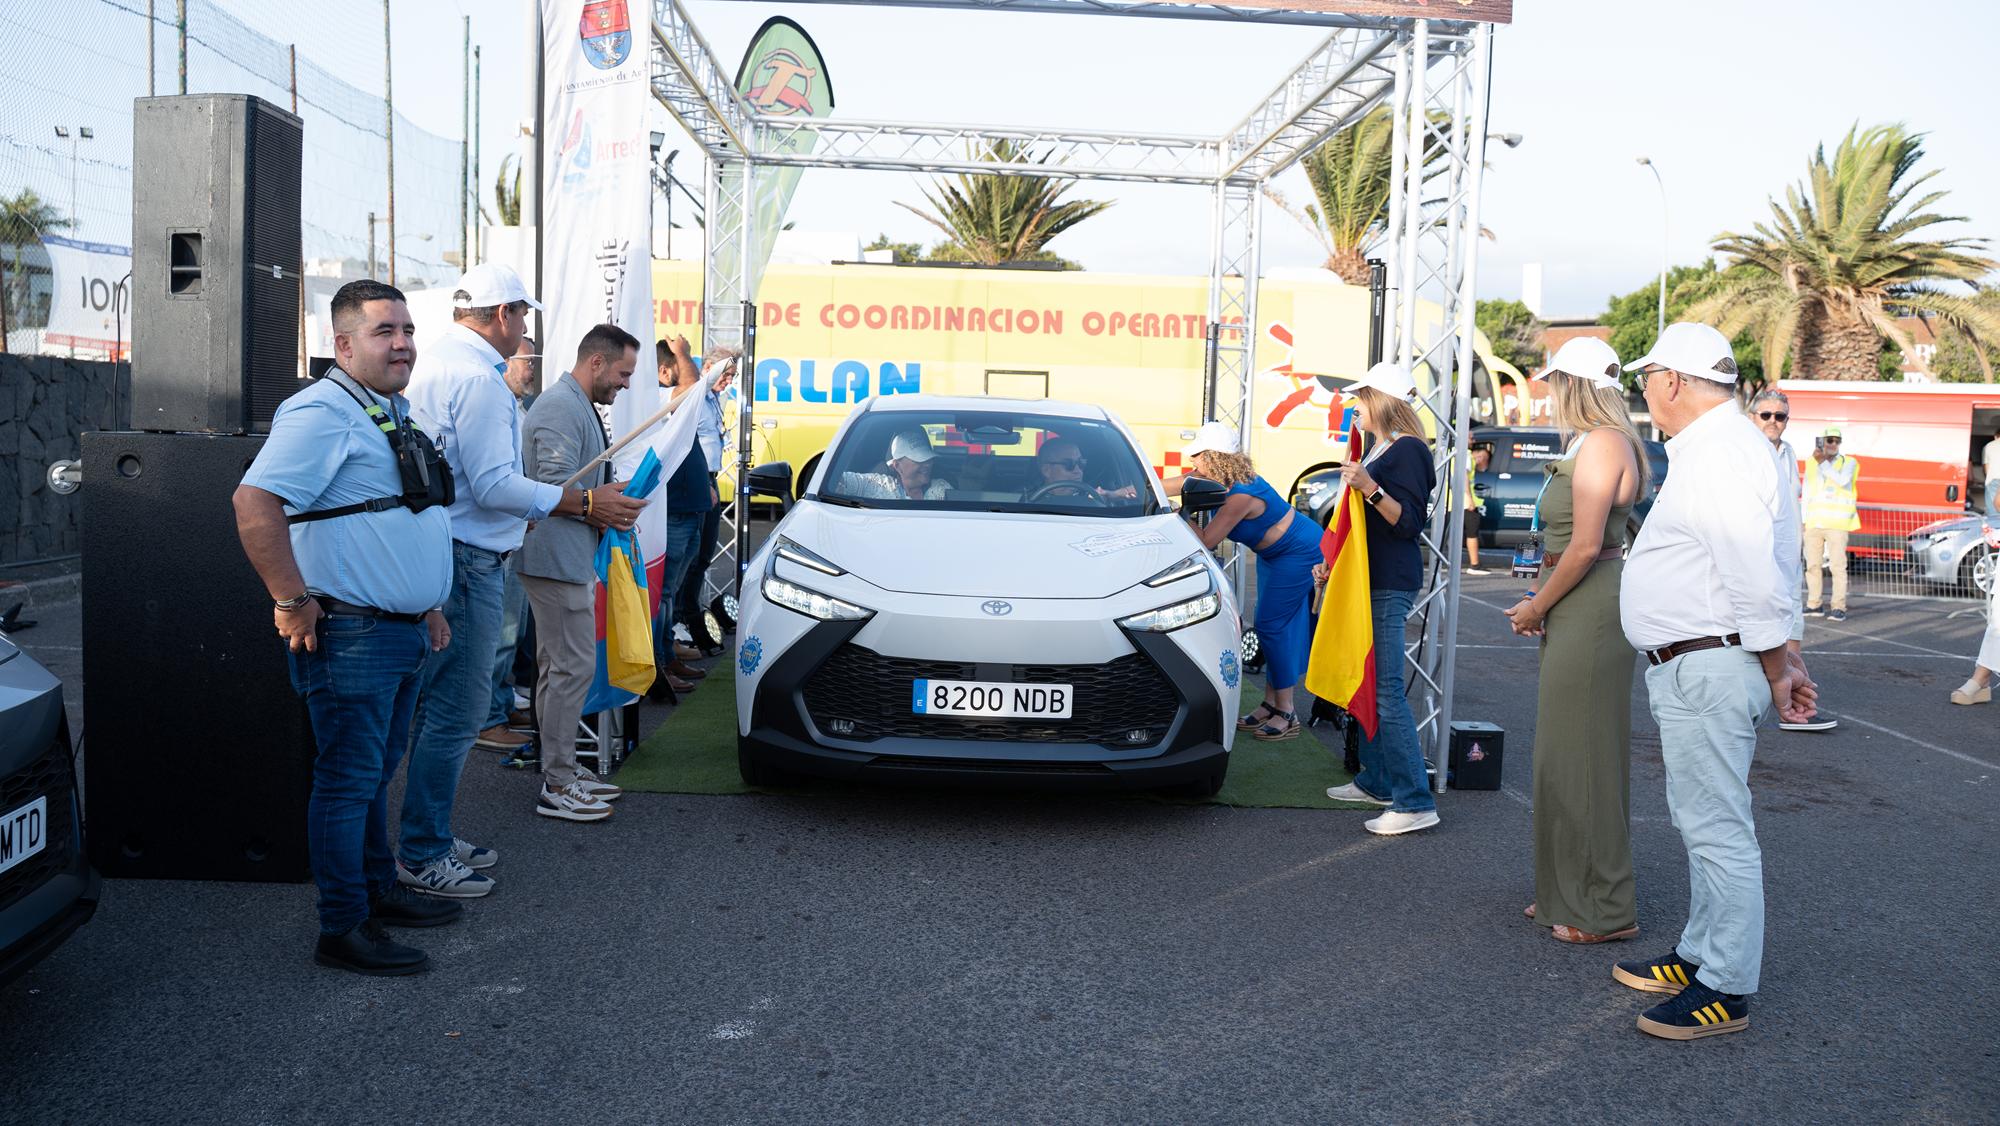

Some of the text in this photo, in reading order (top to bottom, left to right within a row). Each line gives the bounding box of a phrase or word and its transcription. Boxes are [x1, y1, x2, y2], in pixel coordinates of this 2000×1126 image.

[762, 302, 801, 327] DE
[819, 303, 1063, 335] COORDINACION
[933, 685, 1065, 713] 8200 NDB
[0, 808, 40, 864] MTD
